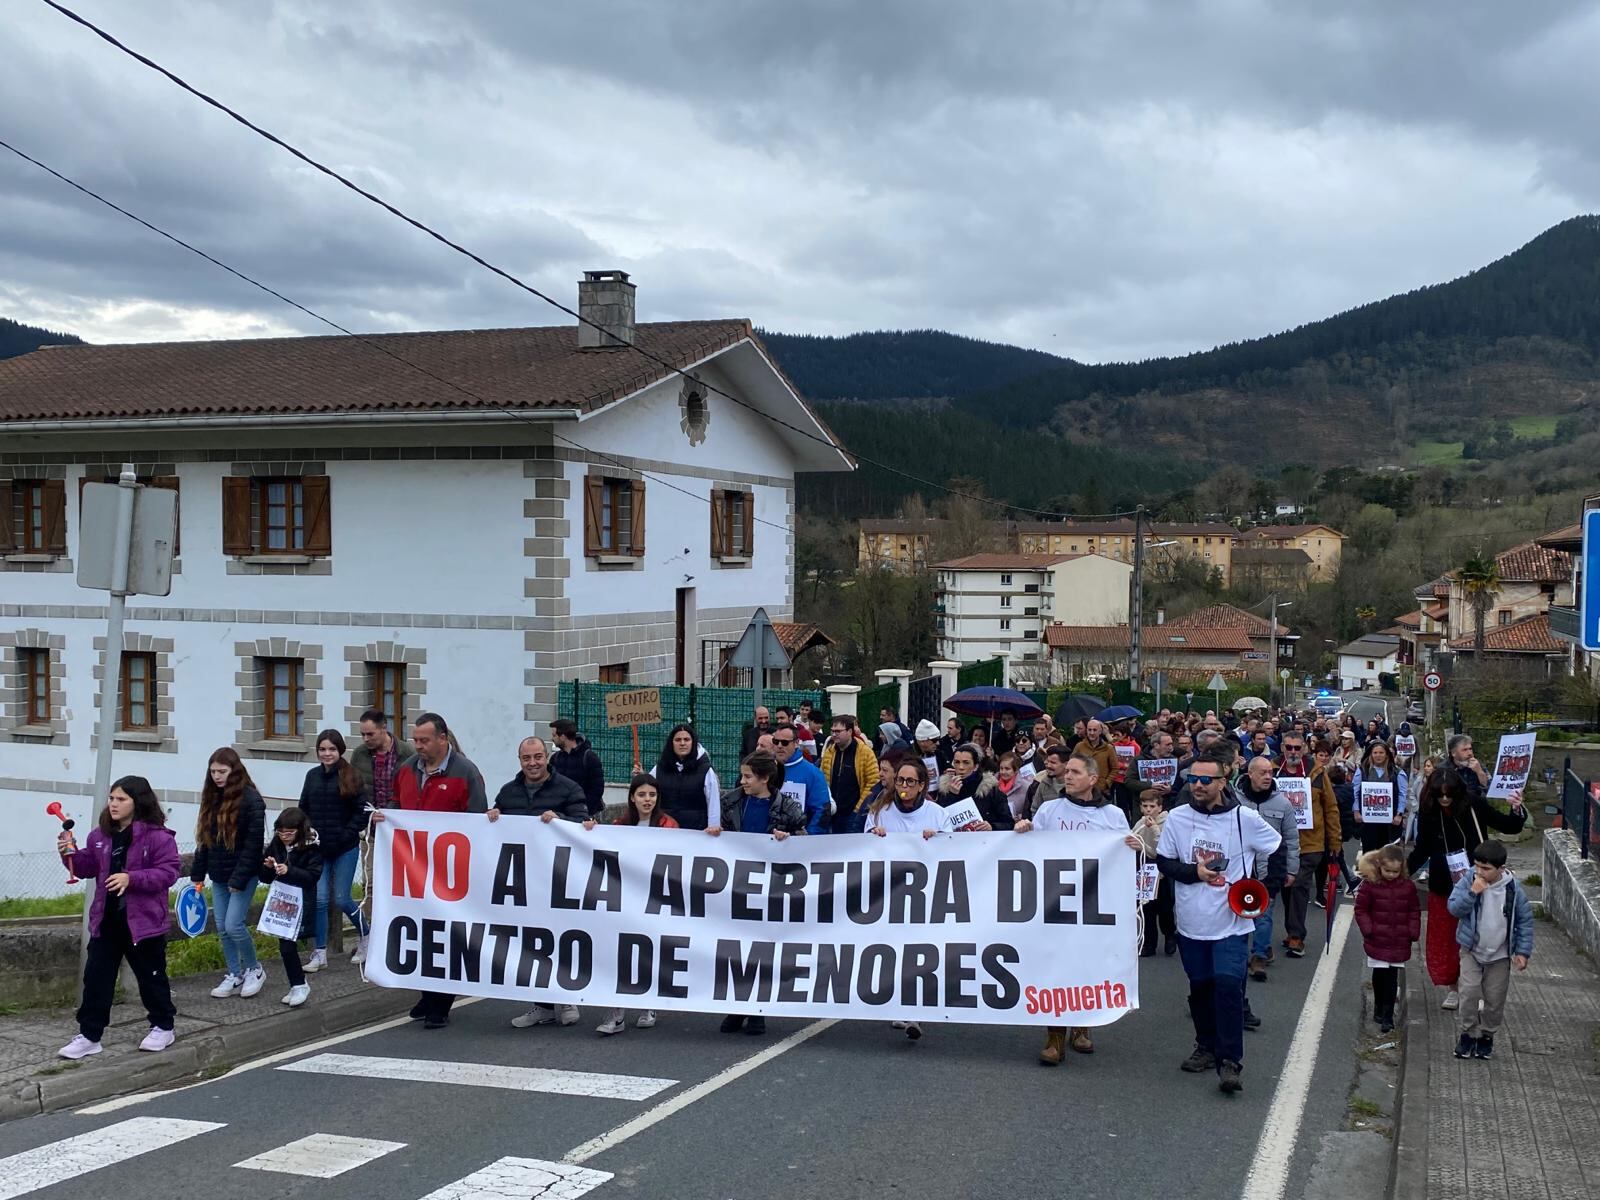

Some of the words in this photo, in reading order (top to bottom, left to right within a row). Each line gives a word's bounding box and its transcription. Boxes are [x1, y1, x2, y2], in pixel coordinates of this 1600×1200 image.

[616, 710, 661, 724] ROTONDA
[391, 828, 471, 902] NO
[491, 843, 527, 907] A
[550, 846, 622, 912] LA
[645, 853, 971, 926] APERTURA
[996, 858, 1116, 926] DEL
[385, 915, 593, 992] CENTRO
[615, 933, 690, 999] DE
[712, 938, 1021, 1010] MENORES
[1025, 980, 1128, 1018] Sopuerta
